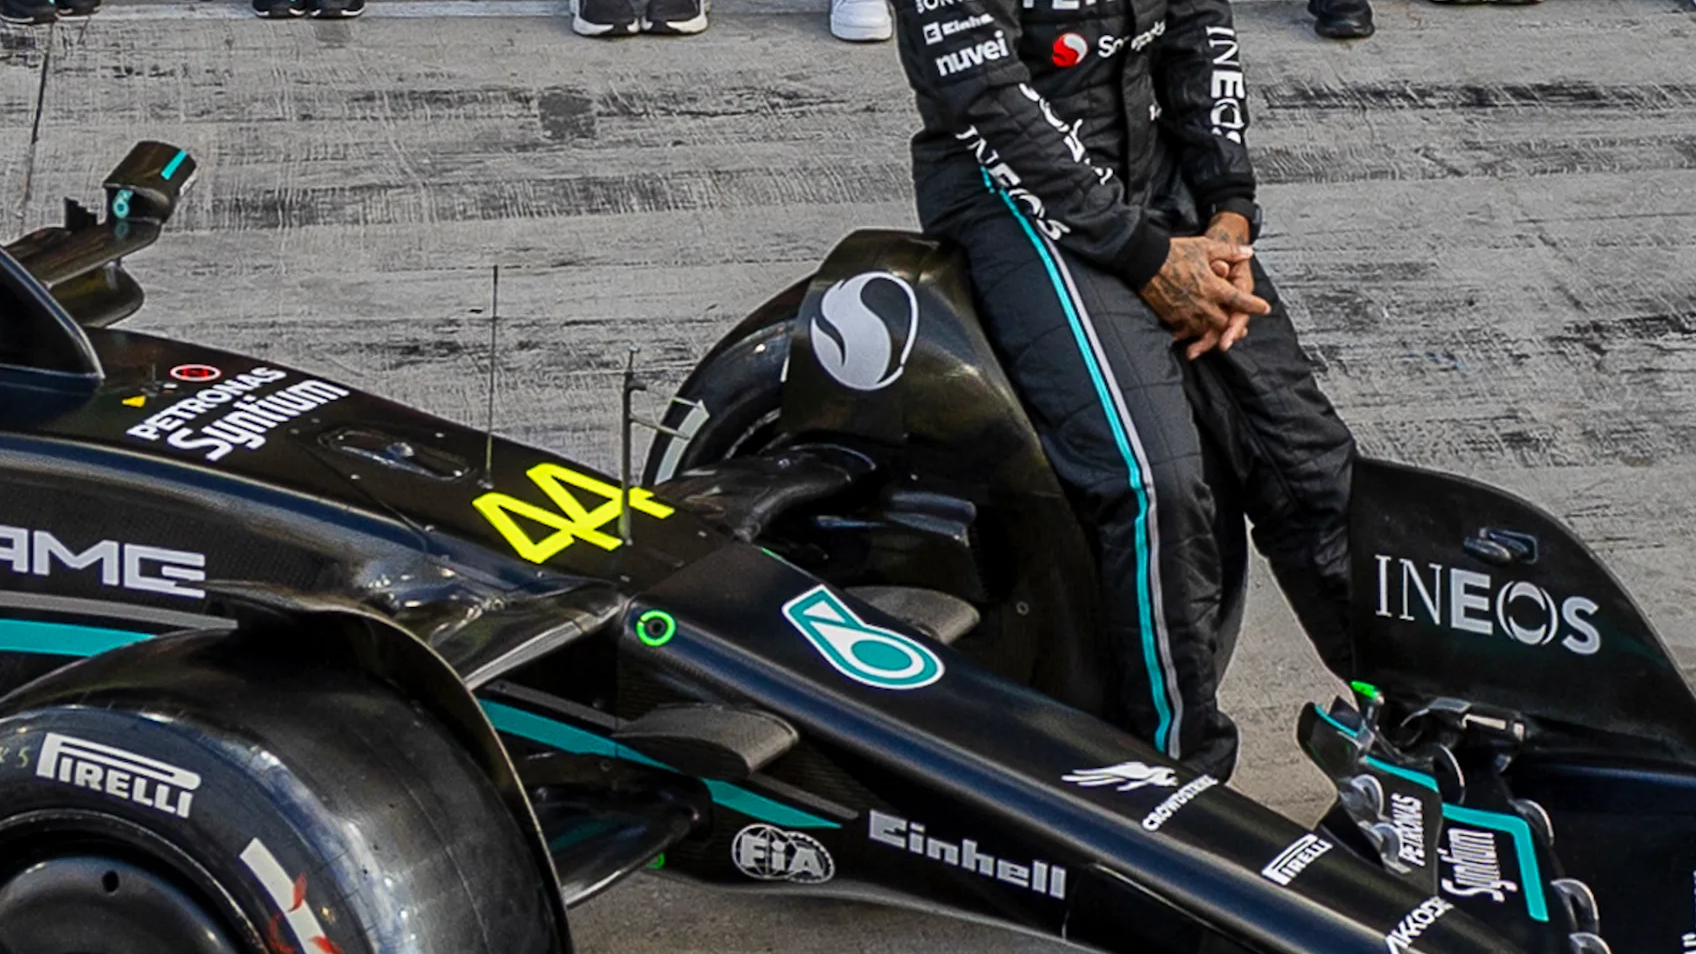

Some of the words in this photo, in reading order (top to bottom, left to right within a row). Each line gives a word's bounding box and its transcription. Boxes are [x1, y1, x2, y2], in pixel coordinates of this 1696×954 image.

[936, 30, 1009, 76] nuvei
[126, 366, 287, 440] PETRONAS
[167, 380, 350, 461] Syntium
[472, 463, 675, 564] 44
[1374, 554, 1601, 655] INEOS
[36, 732, 201, 818] PIRELLI
[869, 809, 1065, 900] Einhell
[1261, 833, 1333, 886] PIRELLI
[1437, 828, 1518, 902] Syntium
